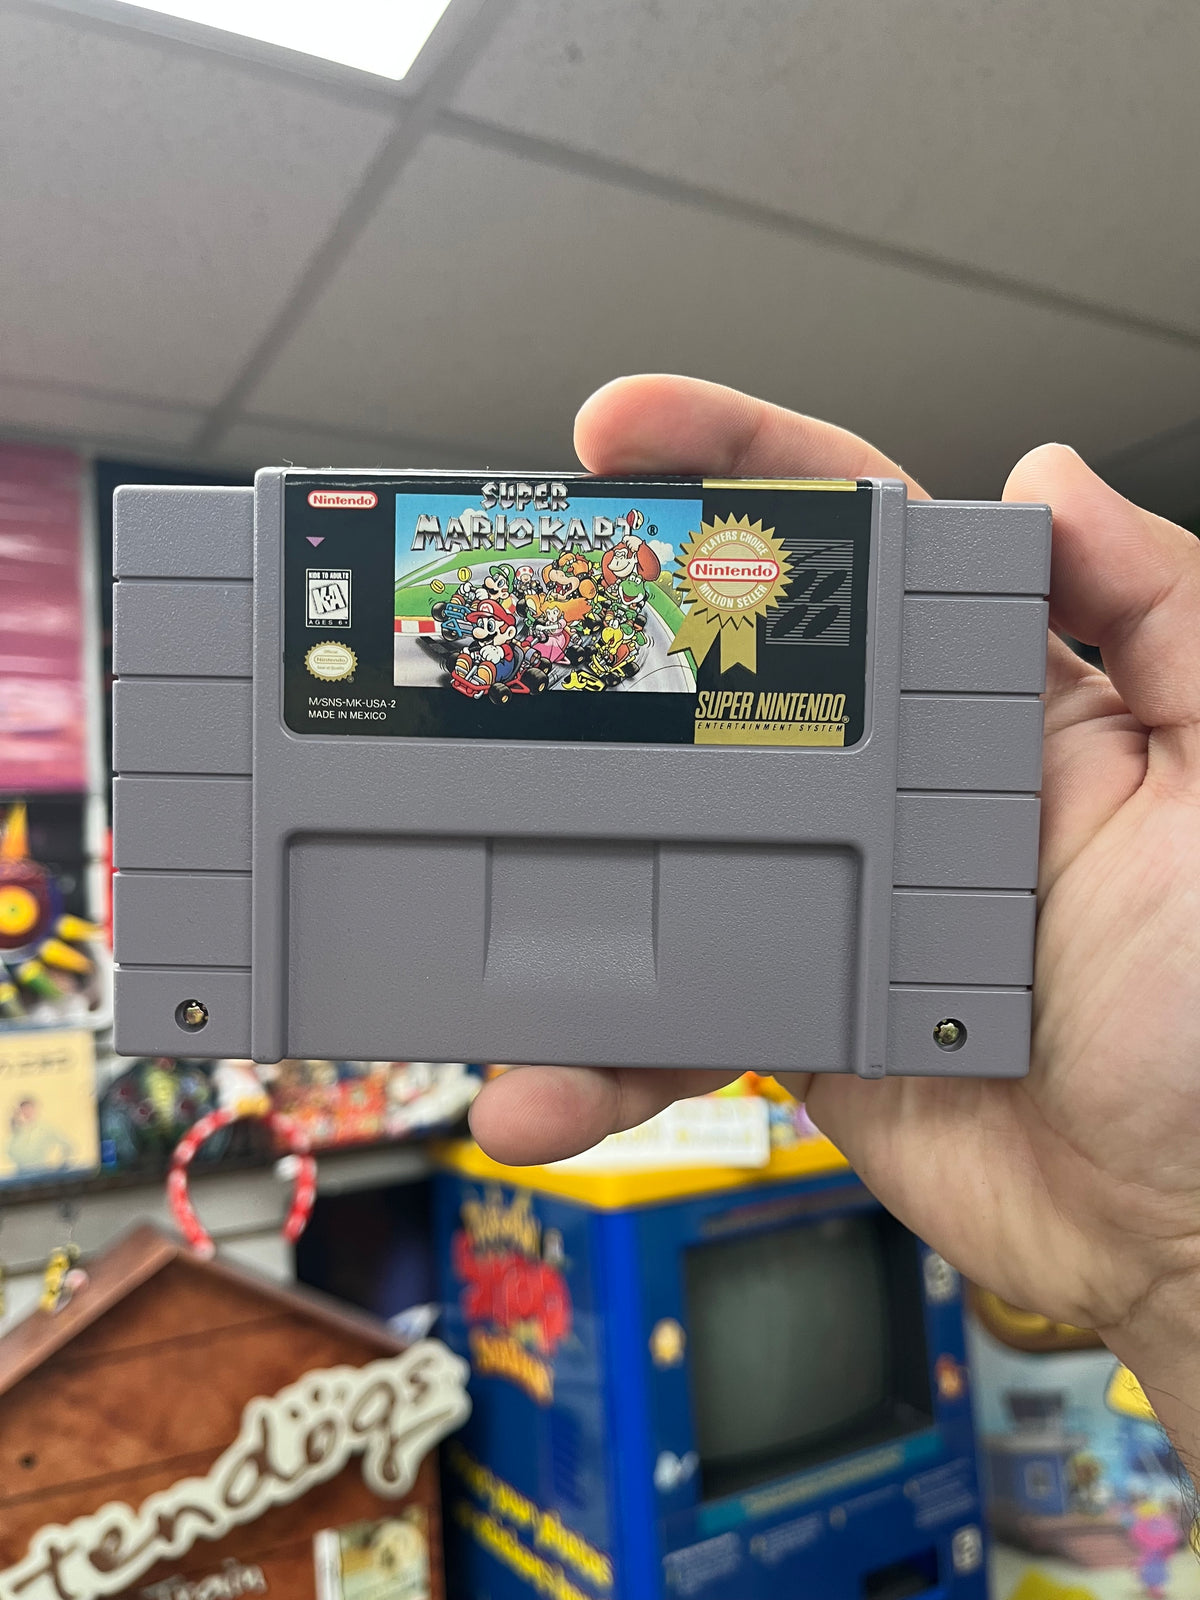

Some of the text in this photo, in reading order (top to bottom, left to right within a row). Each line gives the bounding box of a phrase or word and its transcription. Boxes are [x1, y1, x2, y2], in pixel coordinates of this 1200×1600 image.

[313, 495, 372, 505] Nintendo
[480, 482, 570, 511] SUPER
[410, 514, 632, 553] MARIO KART
[700, 531, 769, 556] PLAYERS CHOICE
[695, 563, 773, 577] Nintendo
[699, 583, 768, 608] MILLION SELLER
[308, 697, 397, 709] M/SNS-MK-USA-2
[695, 690, 847, 722] SUPER NINTENDO
[308, 710, 387, 721] MADE IN MEXICO
[697, 721, 844, 732] ENTERTAINMENT SYSTEM
